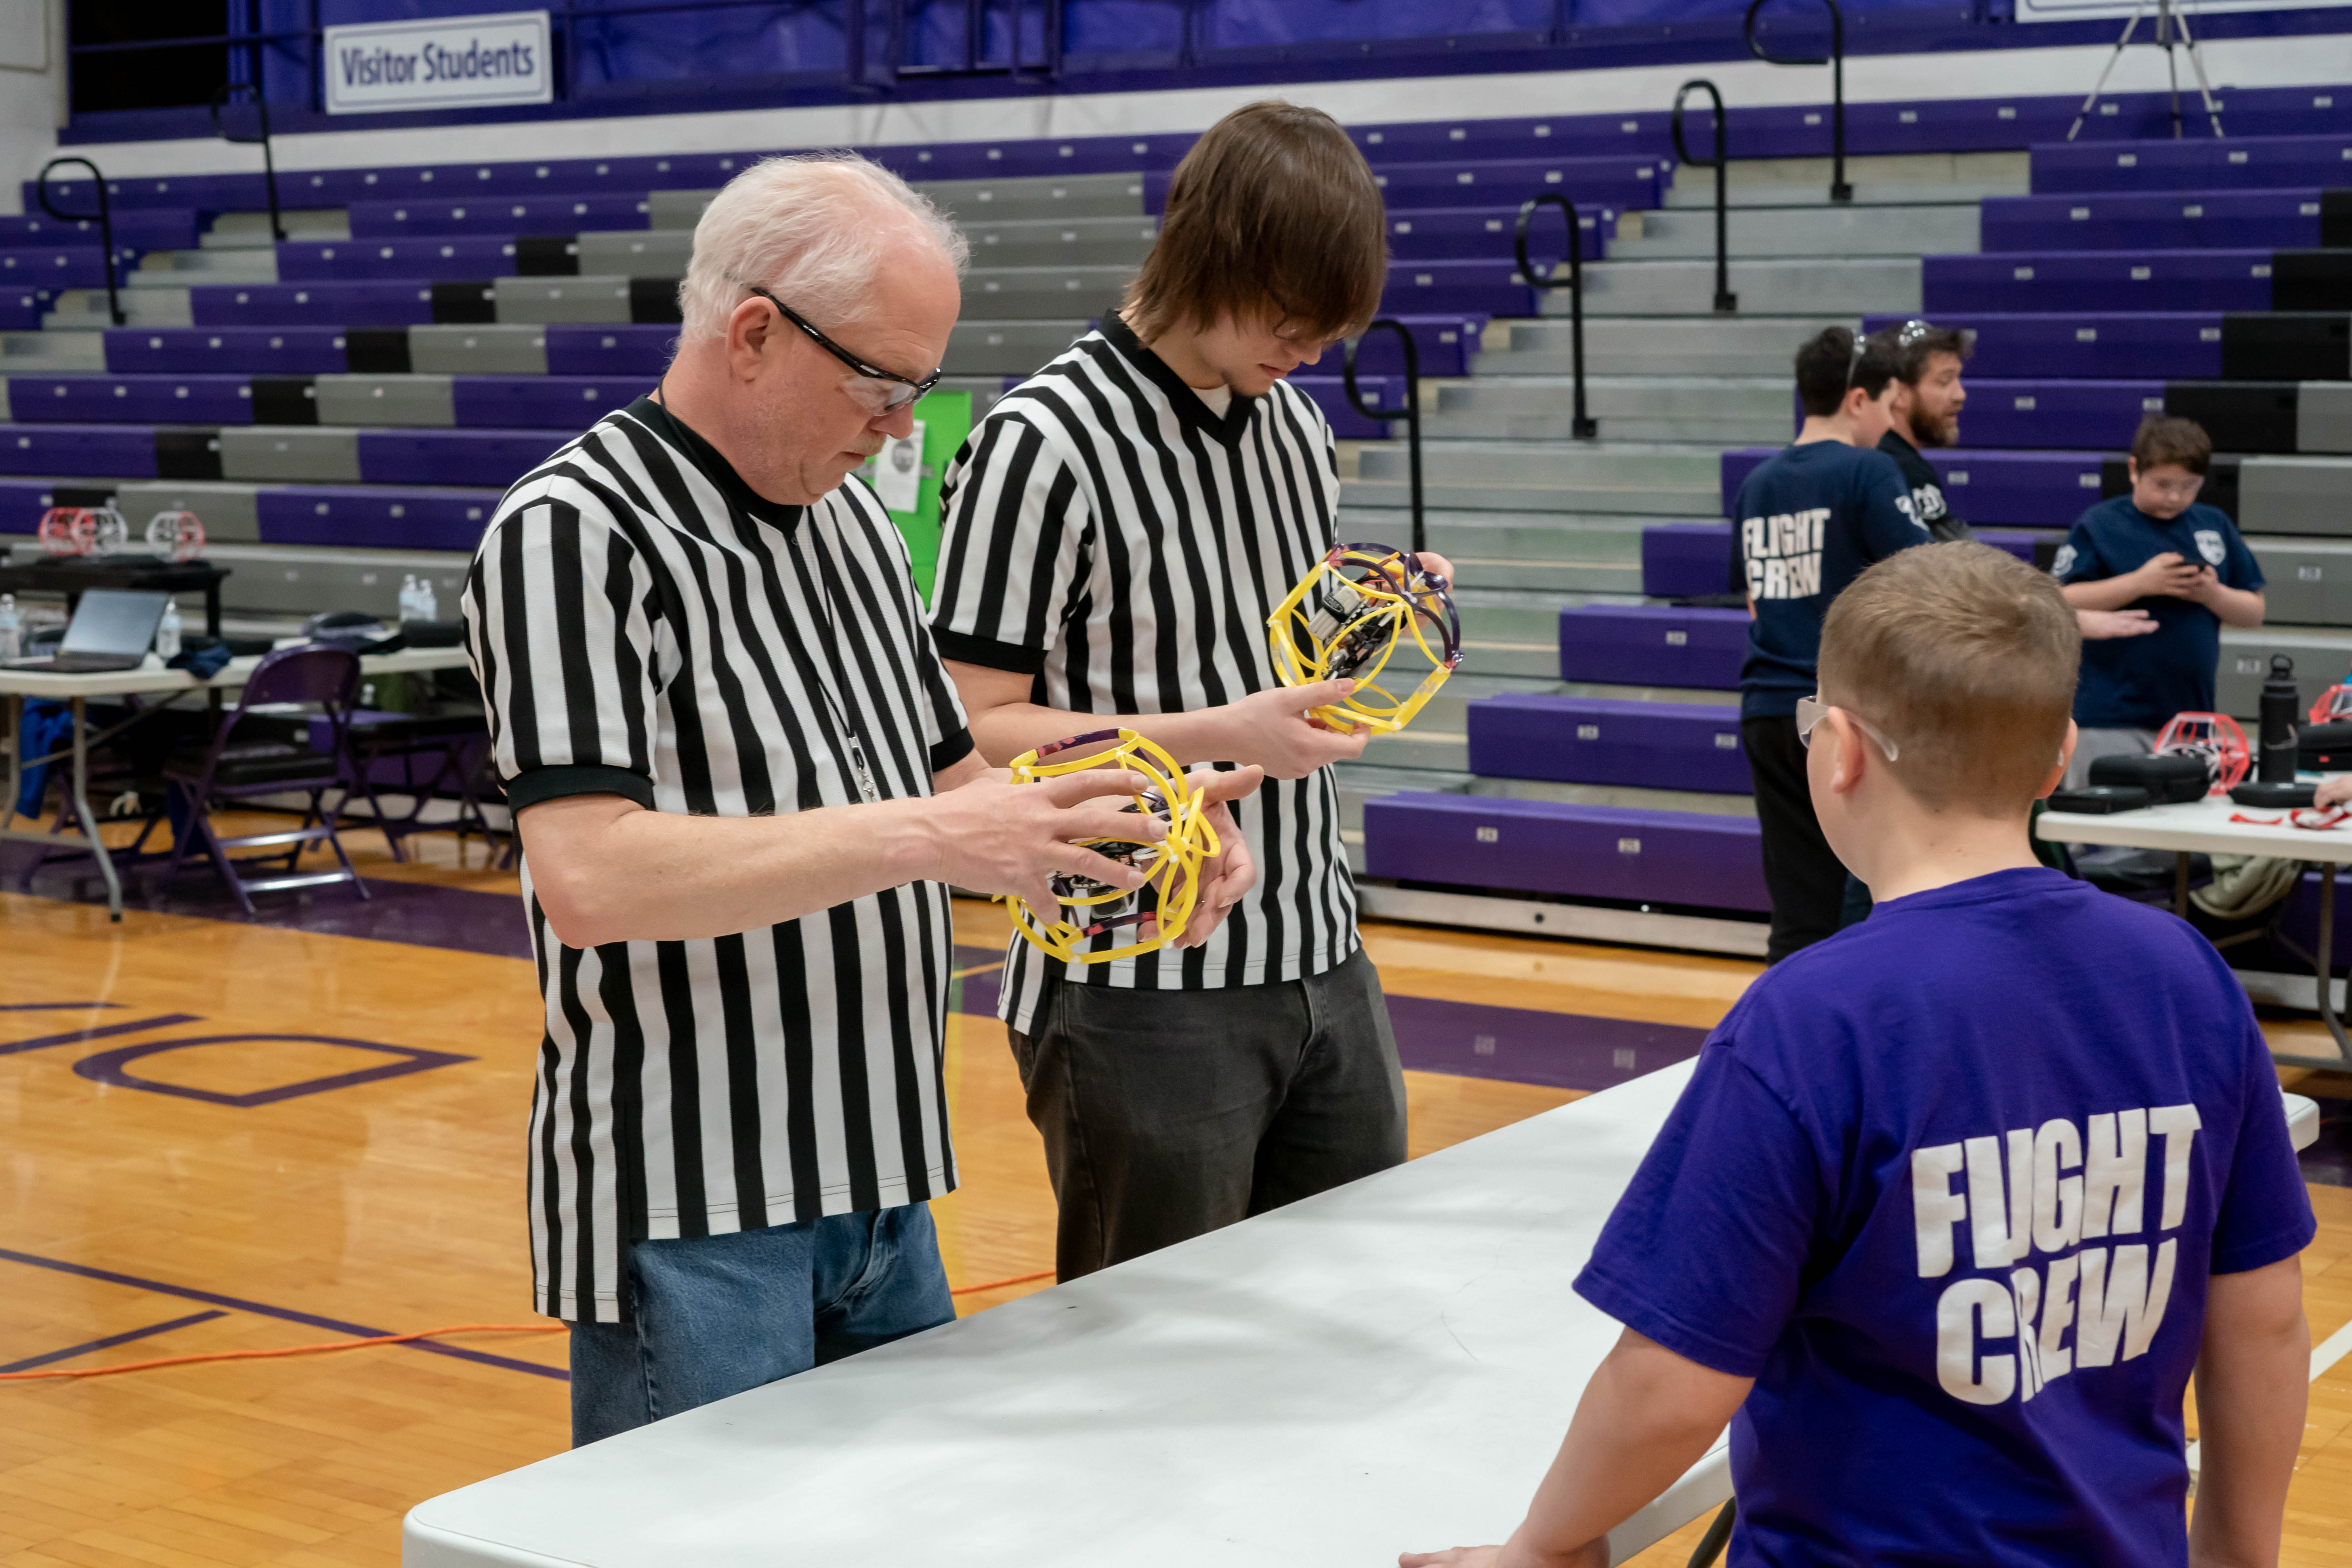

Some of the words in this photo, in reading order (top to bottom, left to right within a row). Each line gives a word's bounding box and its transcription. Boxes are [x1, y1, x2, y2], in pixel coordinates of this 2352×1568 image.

[341, 46, 417, 86] Visitor
[423, 38, 533, 82] Students
[1742, 508, 1831, 560] FLIGHT
[1745, 552, 1822, 600] CREW
[1911, 1103, 2201, 1278] FLIGHT
[1937, 1238, 2177, 1405] CREW
